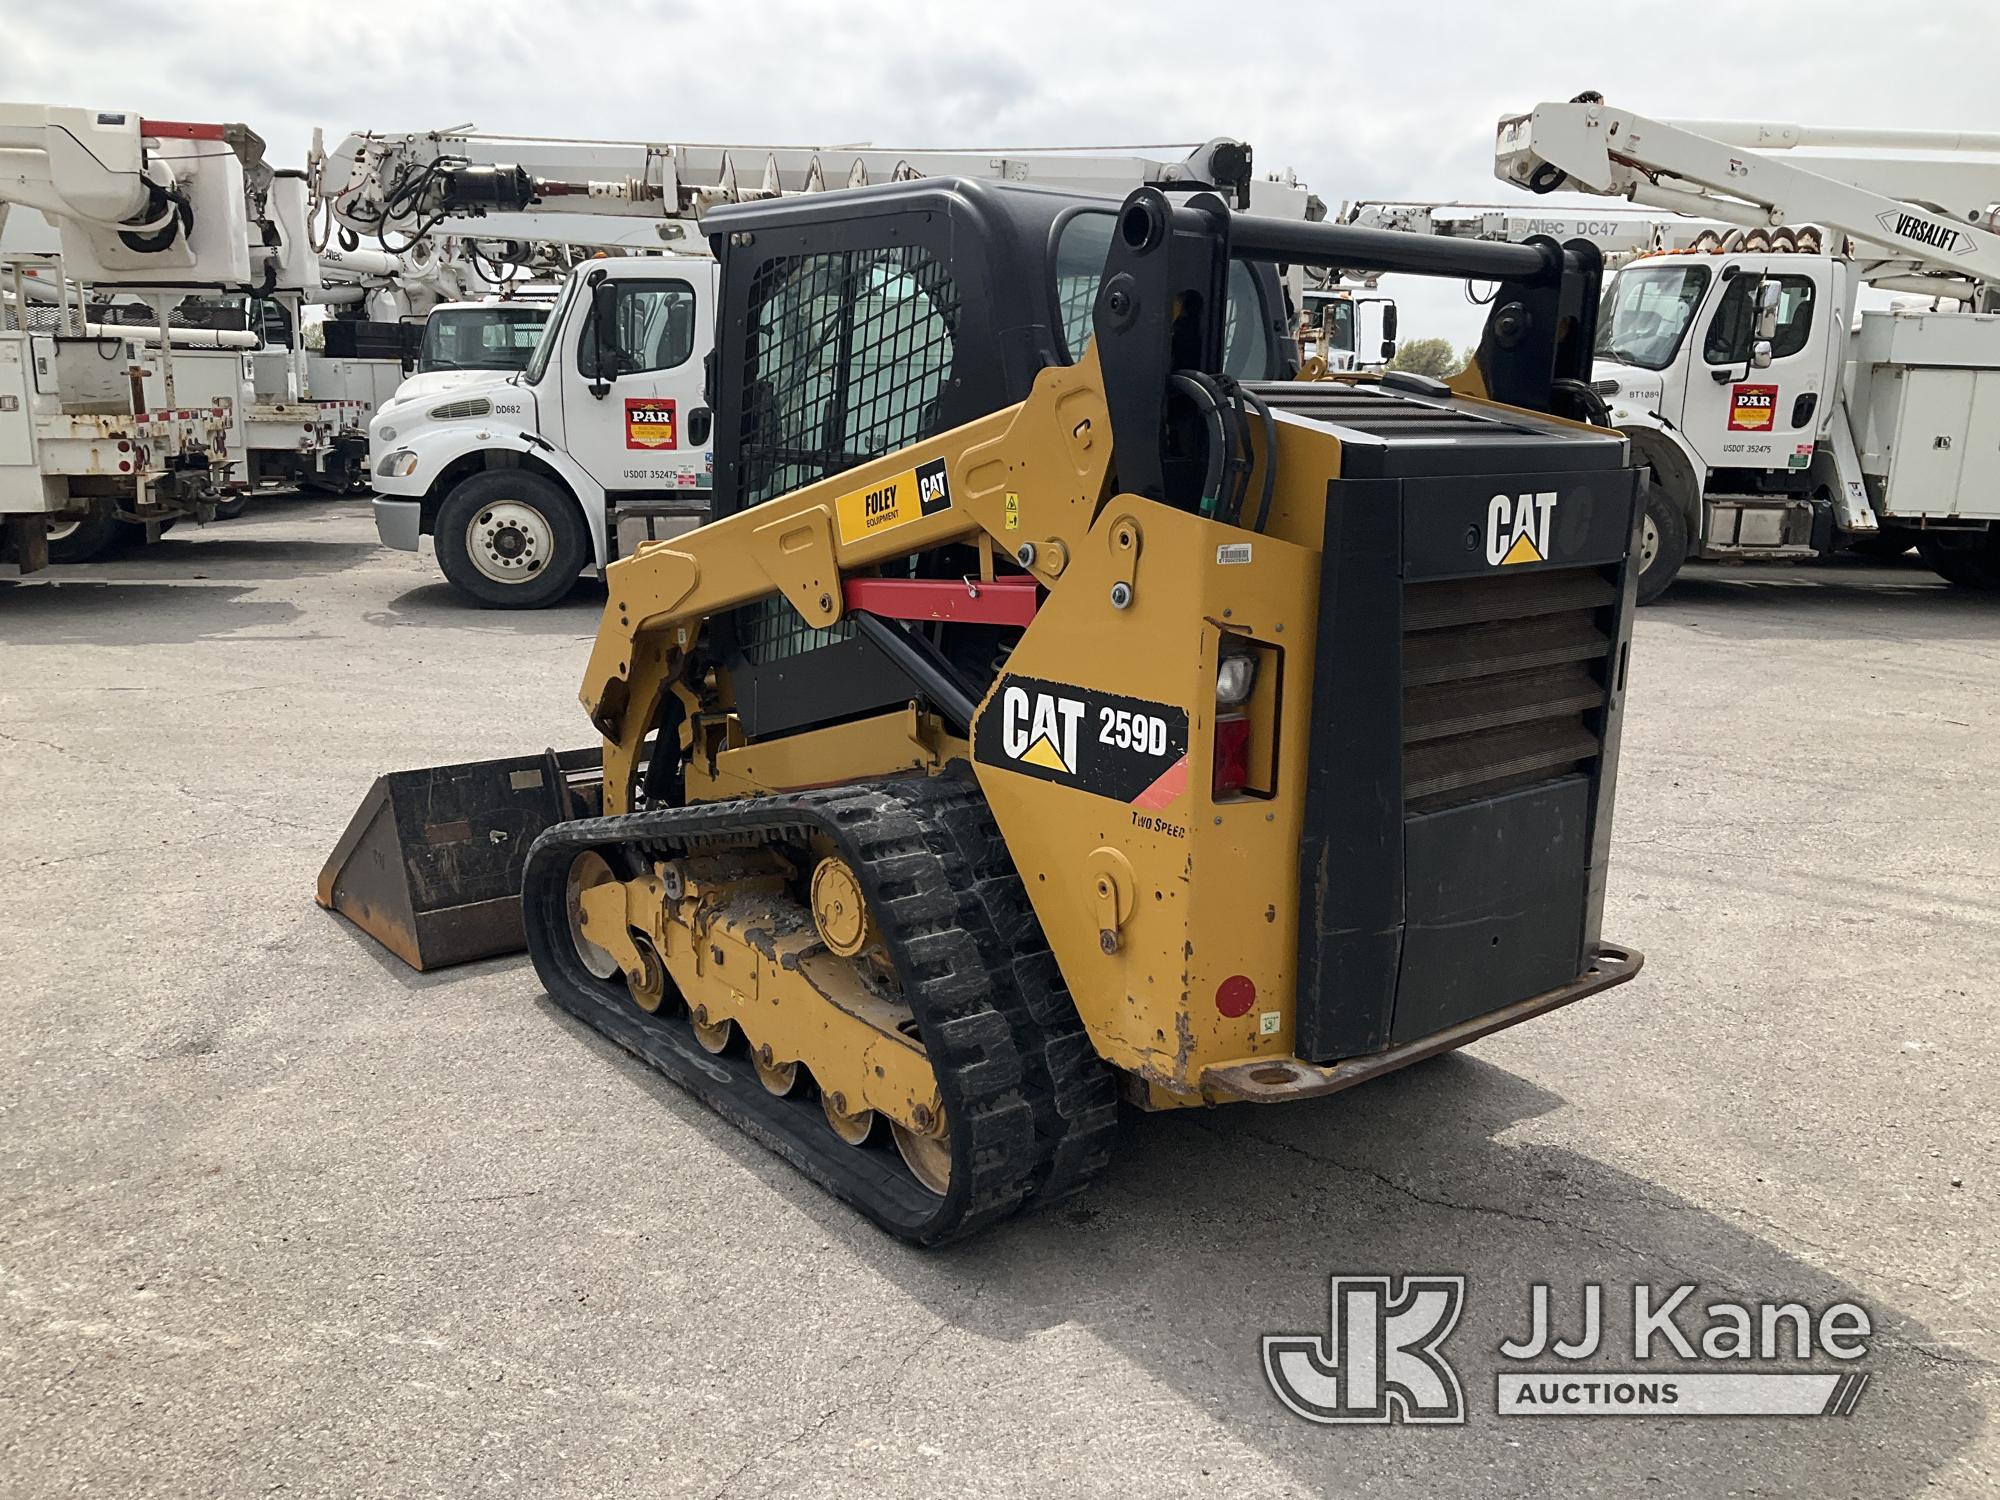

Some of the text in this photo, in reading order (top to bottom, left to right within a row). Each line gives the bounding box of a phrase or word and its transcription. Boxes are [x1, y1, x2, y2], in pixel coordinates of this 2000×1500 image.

[1526, 219, 1618, 236] Altec DC47
[1895, 213, 1959, 251] VERSALIFT
[495, 405, 521, 414] DD682
[1737, 396, 1771, 406] PAR
[632, 411, 670, 423] PAR
[1723, 445, 1772, 454] USDOT 352475
[624, 470, 678, 480] USDOT 352475
[920, 472, 946, 503] CAT
[865, 484, 897, 517] FOLEY
[866, 509, 900, 528] EQUIPMENT
[1486, 492, 1557, 566] CAT
[1003, 686, 1168, 775] CAT 259D
